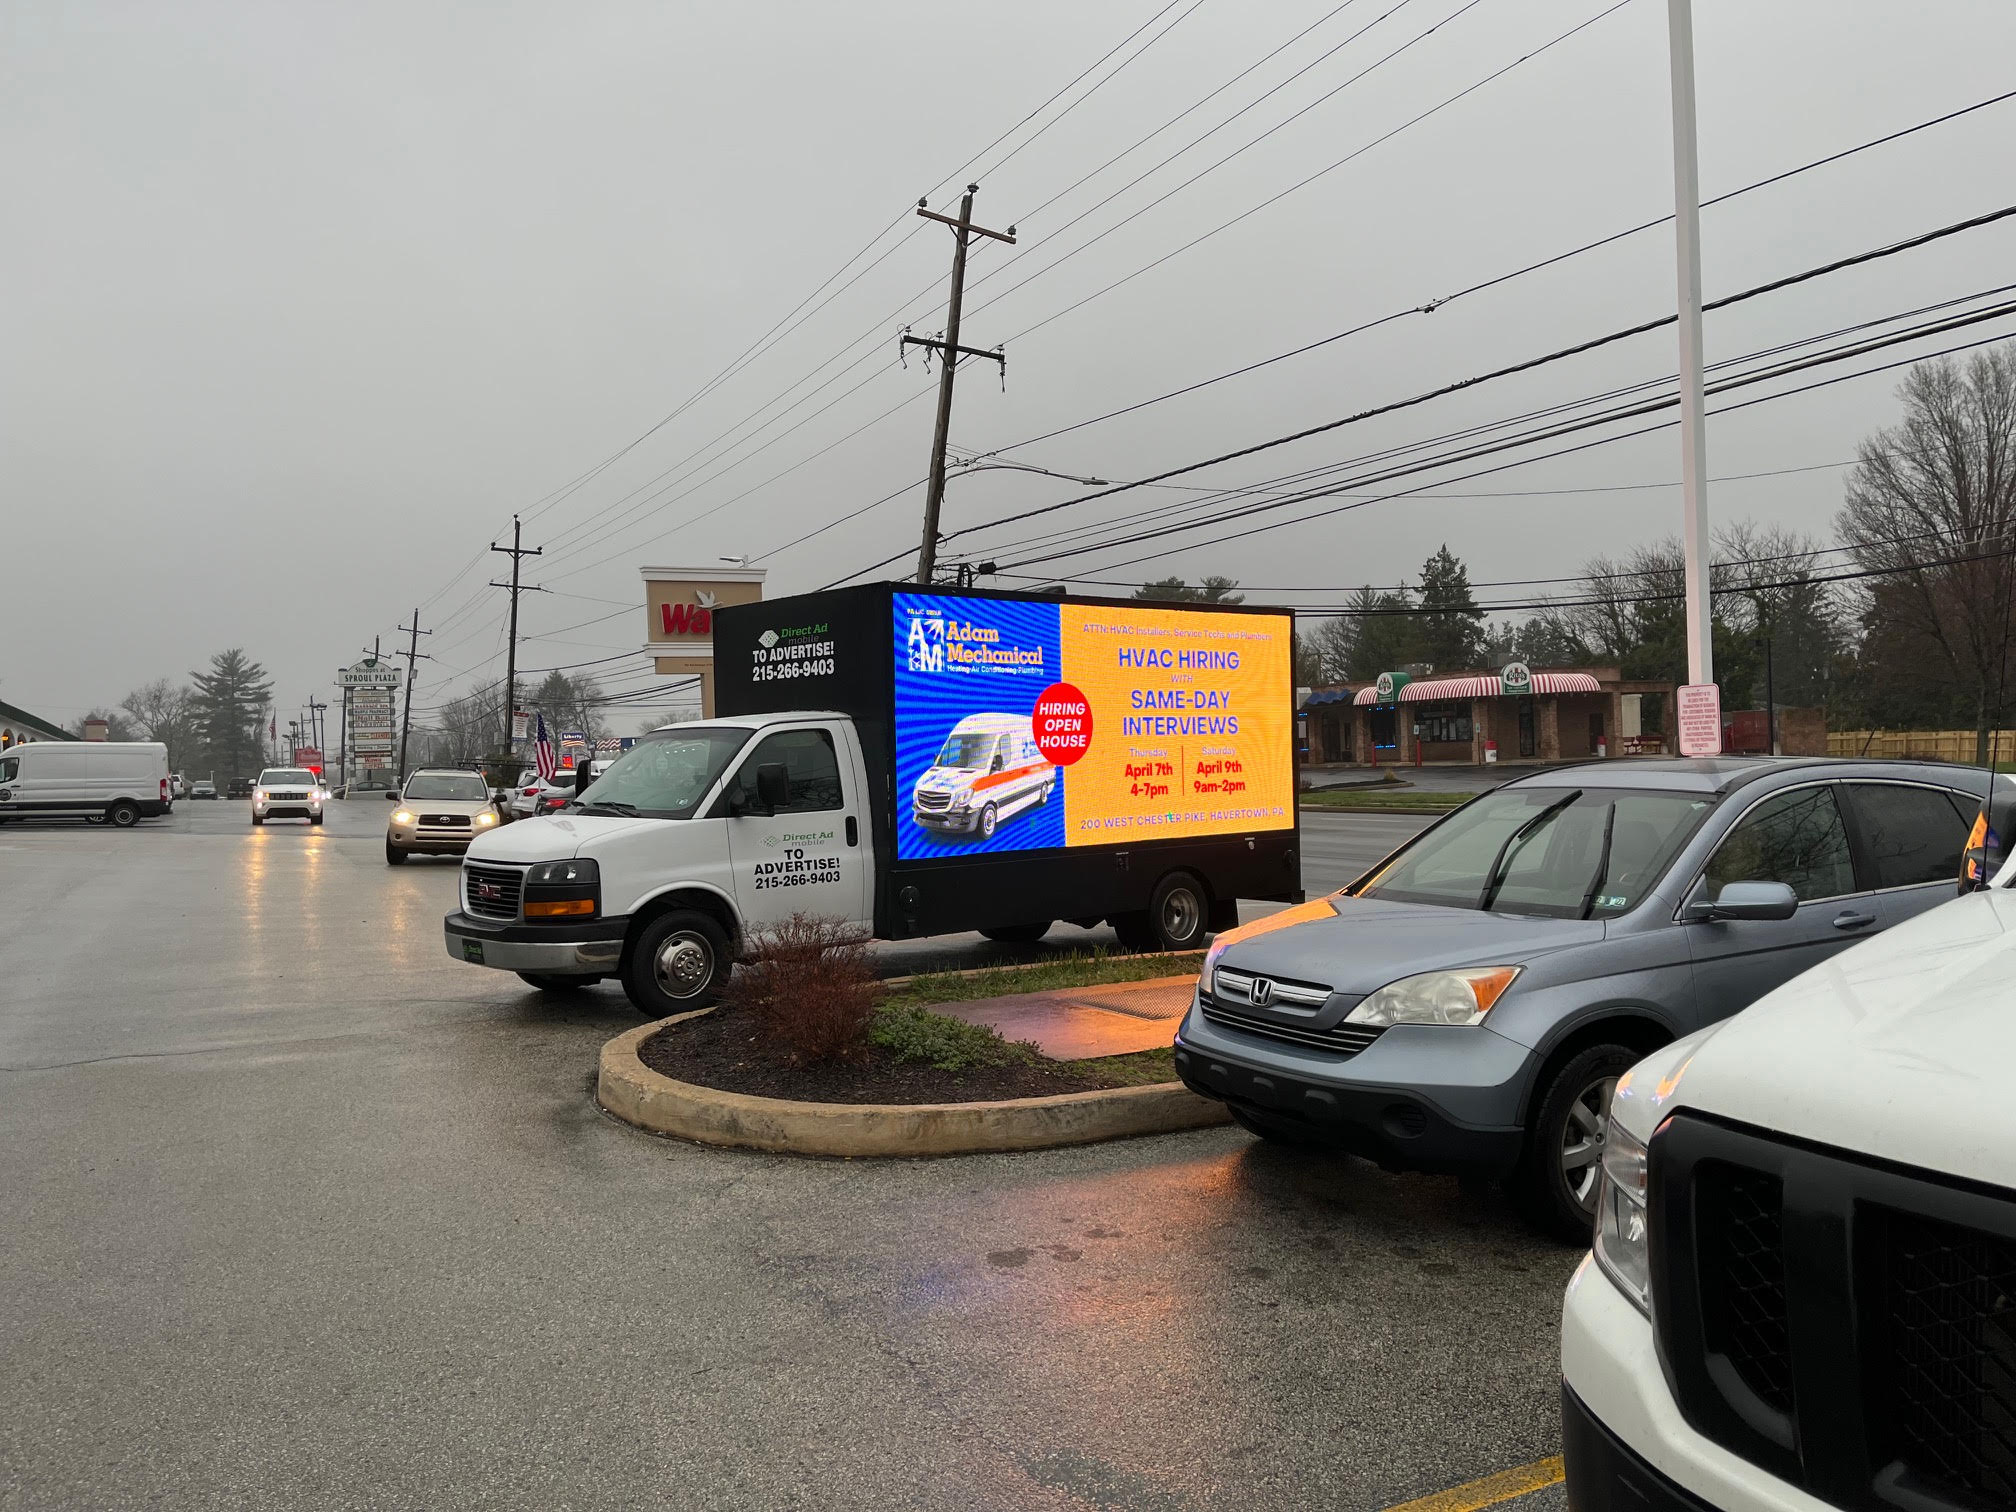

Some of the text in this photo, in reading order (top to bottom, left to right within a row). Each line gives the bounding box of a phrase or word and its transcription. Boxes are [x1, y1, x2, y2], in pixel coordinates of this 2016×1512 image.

[781, 623, 829, 638] Direct Ad
[946, 621, 1000, 642] Adam
[1110, 625, 1134, 635] HVAC
[1174, 628, 1202, 638] Service
[1203, 630, 1225, 639] Techs
[1227, 631, 1239, 640] and
[788, 634, 820, 645] mobile
[752, 641, 834, 663] TO ADVERTISE!
[946, 643, 1044, 665] Mechanical
[1118, 648, 1240, 670] HVAC HIRING
[345, 674, 397, 682] SPROUL PLAZA
[752, 658, 835, 682] 215-266-9403
[1171, 674, 1193, 683] WITH
[1131, 689, 1231, 709] SAME-DAY
[1039, 702, 1086, 716] HIRING
[1044, 719, 1082, 732] OPEN
[1123, 716, 1239, 736] INTERVIEWS
[1040, 734, 1086, 748] HOUSE
[1129, 748, 1168, 758] Thursday
[1202, 746, 1236, 756] Saturday
[1125, 763, 1173, 780] April 7th
[1197, 761, 1242, 777] April 9th
[1130, 782, 1169, 799] 4-7pm
[1194, 779, 1246, 796] 9am-2pm
[1080, 820, 1101, 830] 200
[1104, 816, 1134, 828] WEST
[1137, 813, 1182, 826] CHESTER
[1272, 807, 1284, 817] PA
[783, 831, 834, 841] Direct Ad
[791, 839, 825, 847] mobile
[784, 848, 804, 860] TO
[754, 857, 840, 876] ADVERTISE!
[755, 870, 840, 890] 215-266-9403
